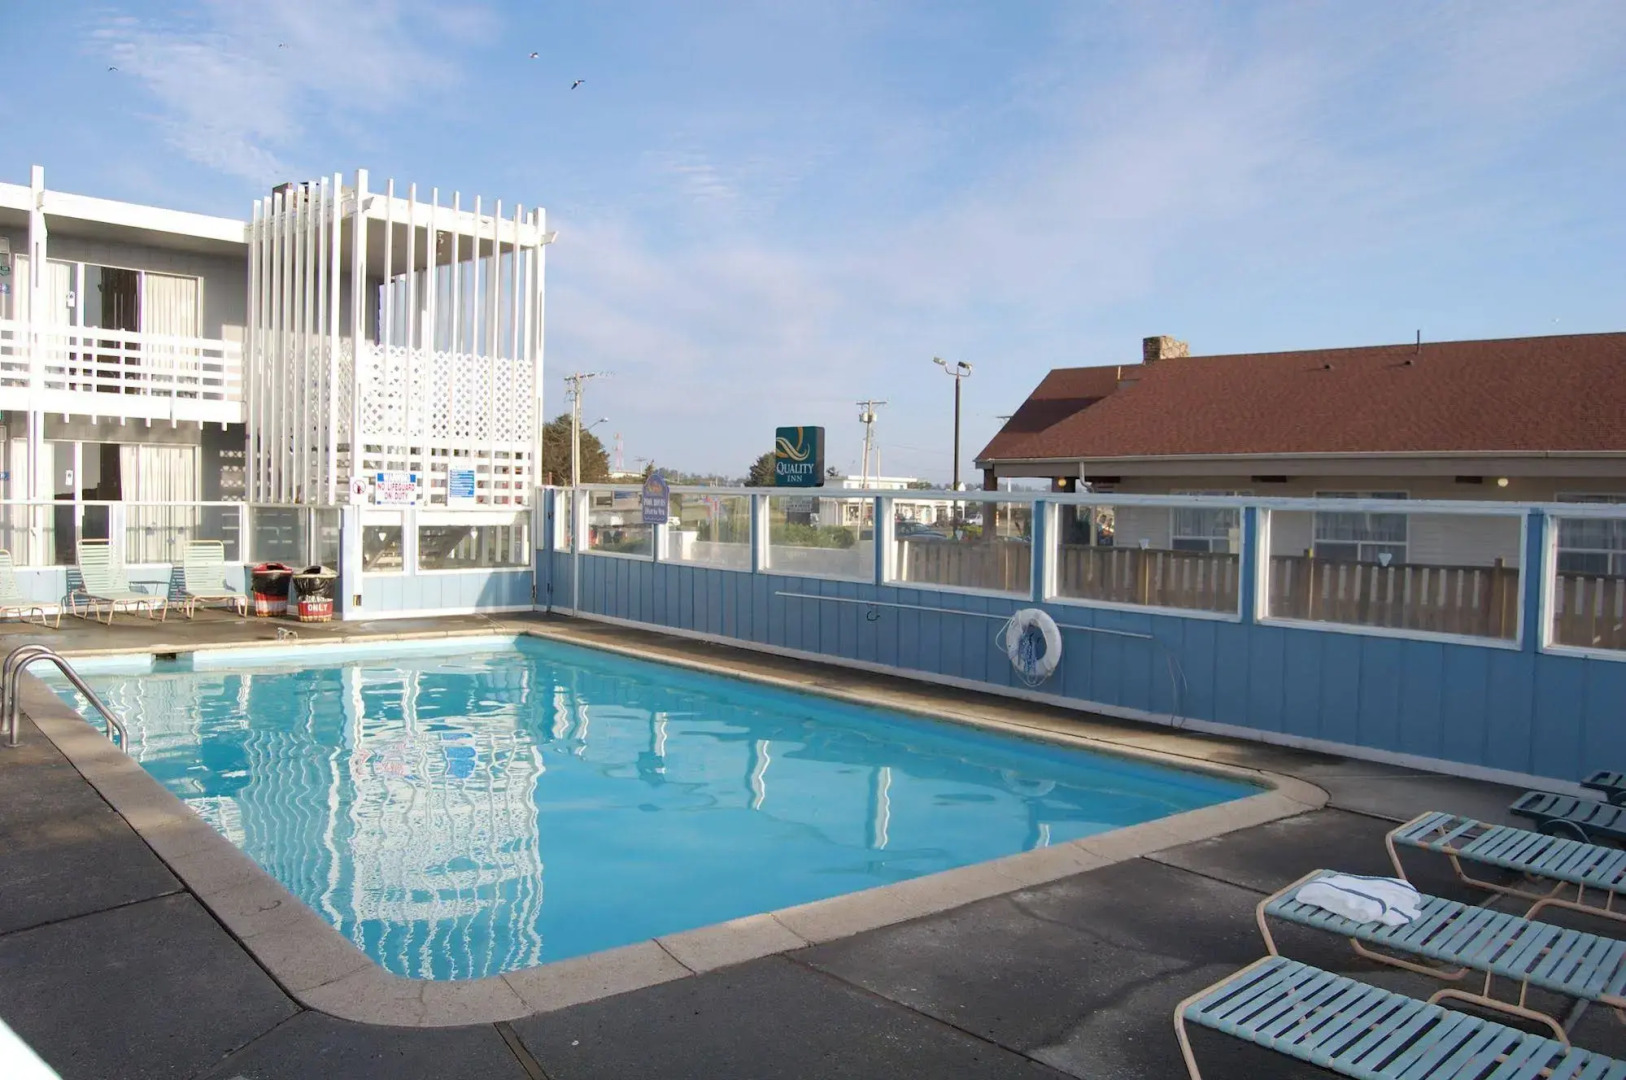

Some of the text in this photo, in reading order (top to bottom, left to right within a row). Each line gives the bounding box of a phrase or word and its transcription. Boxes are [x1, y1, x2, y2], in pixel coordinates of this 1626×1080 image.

[776, 461, 814, 475] QUALITY
[787, 474, 803, 482] INN
[377, 483, 415, 491] NO LIFEGUARD
[384, 491, 408, 500] ON DUTY
